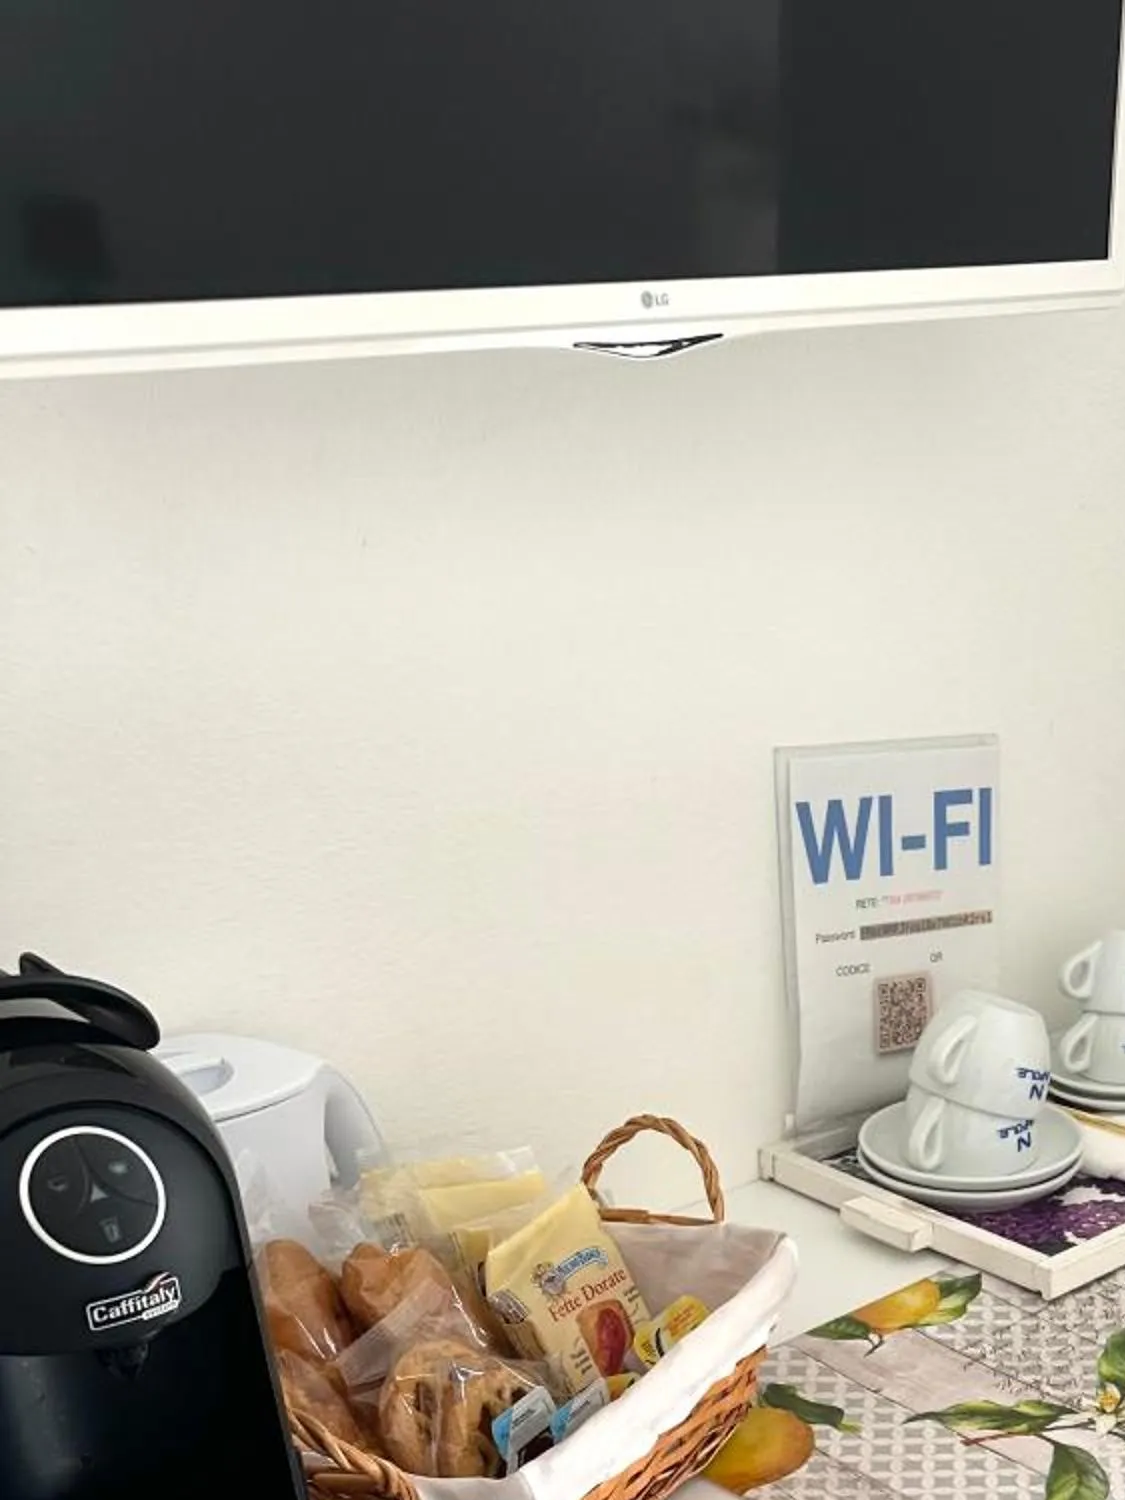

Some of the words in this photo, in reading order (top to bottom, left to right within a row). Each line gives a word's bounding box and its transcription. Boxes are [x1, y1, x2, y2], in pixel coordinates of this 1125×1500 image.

[655, 292, 670, 306] LG
[795, 787, 992, 884] WI-FI
[929, 951, 943, 963] QR
[835, 963, 871, 976] CODICE
[1029, 1084, 1044, 1100] N
[1017, 1131, 1031, 1152] N
[93, 1286, 175, 1322] Caffitaly
[548, 1295, 582, 1322] Fette
[582, 1268, 627, 1301] Dorate
